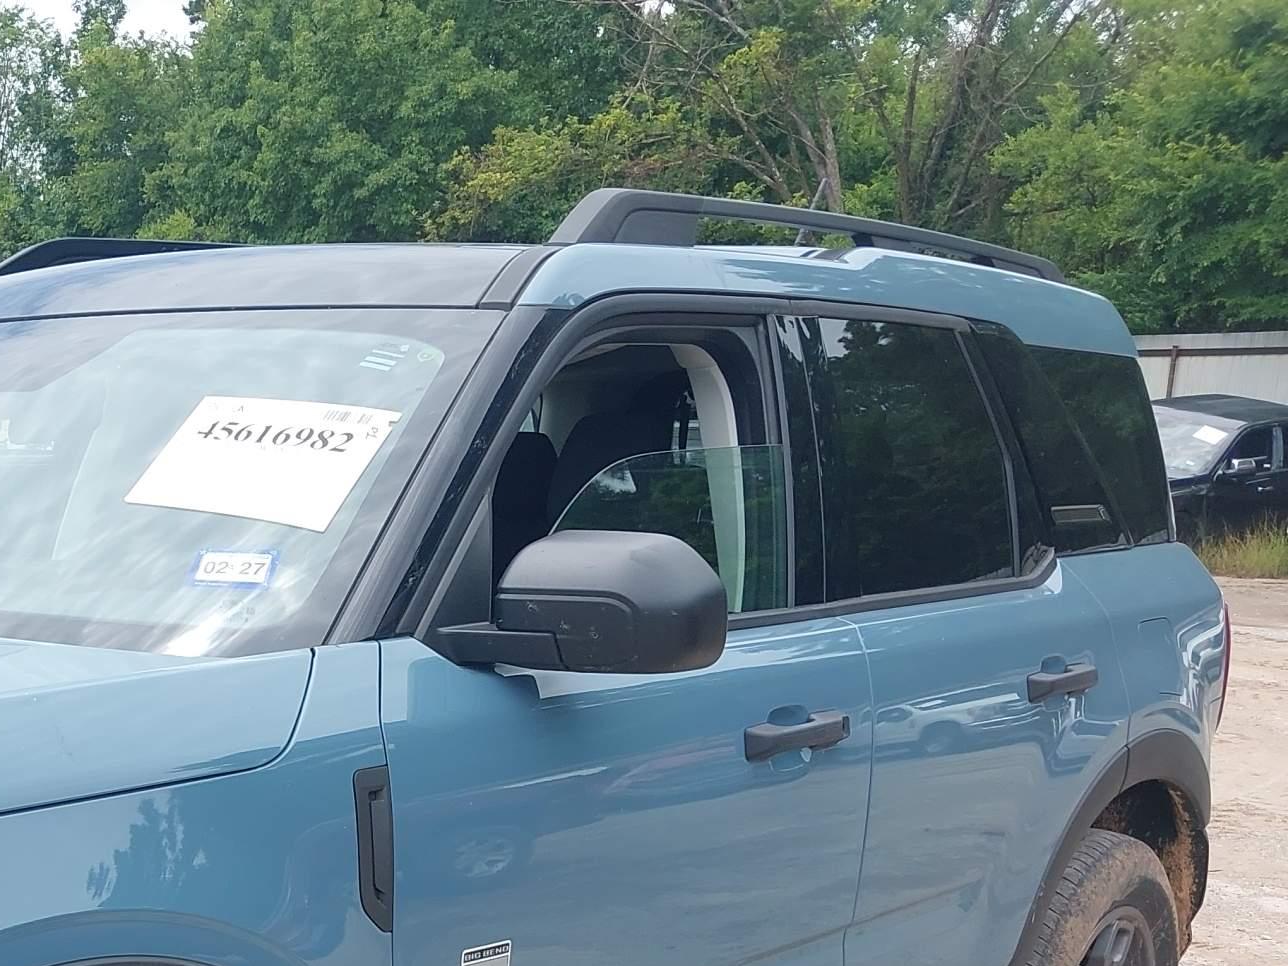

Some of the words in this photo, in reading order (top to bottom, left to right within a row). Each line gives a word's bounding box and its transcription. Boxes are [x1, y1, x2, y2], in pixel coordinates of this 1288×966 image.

[198, 420, 354, 453] 45616982
[204, 561, 229, 574] 02
[239, 562, 266, 575] 27
[464, 951, 481, 961] BIG
[482, 945, 509, 957] BEND
